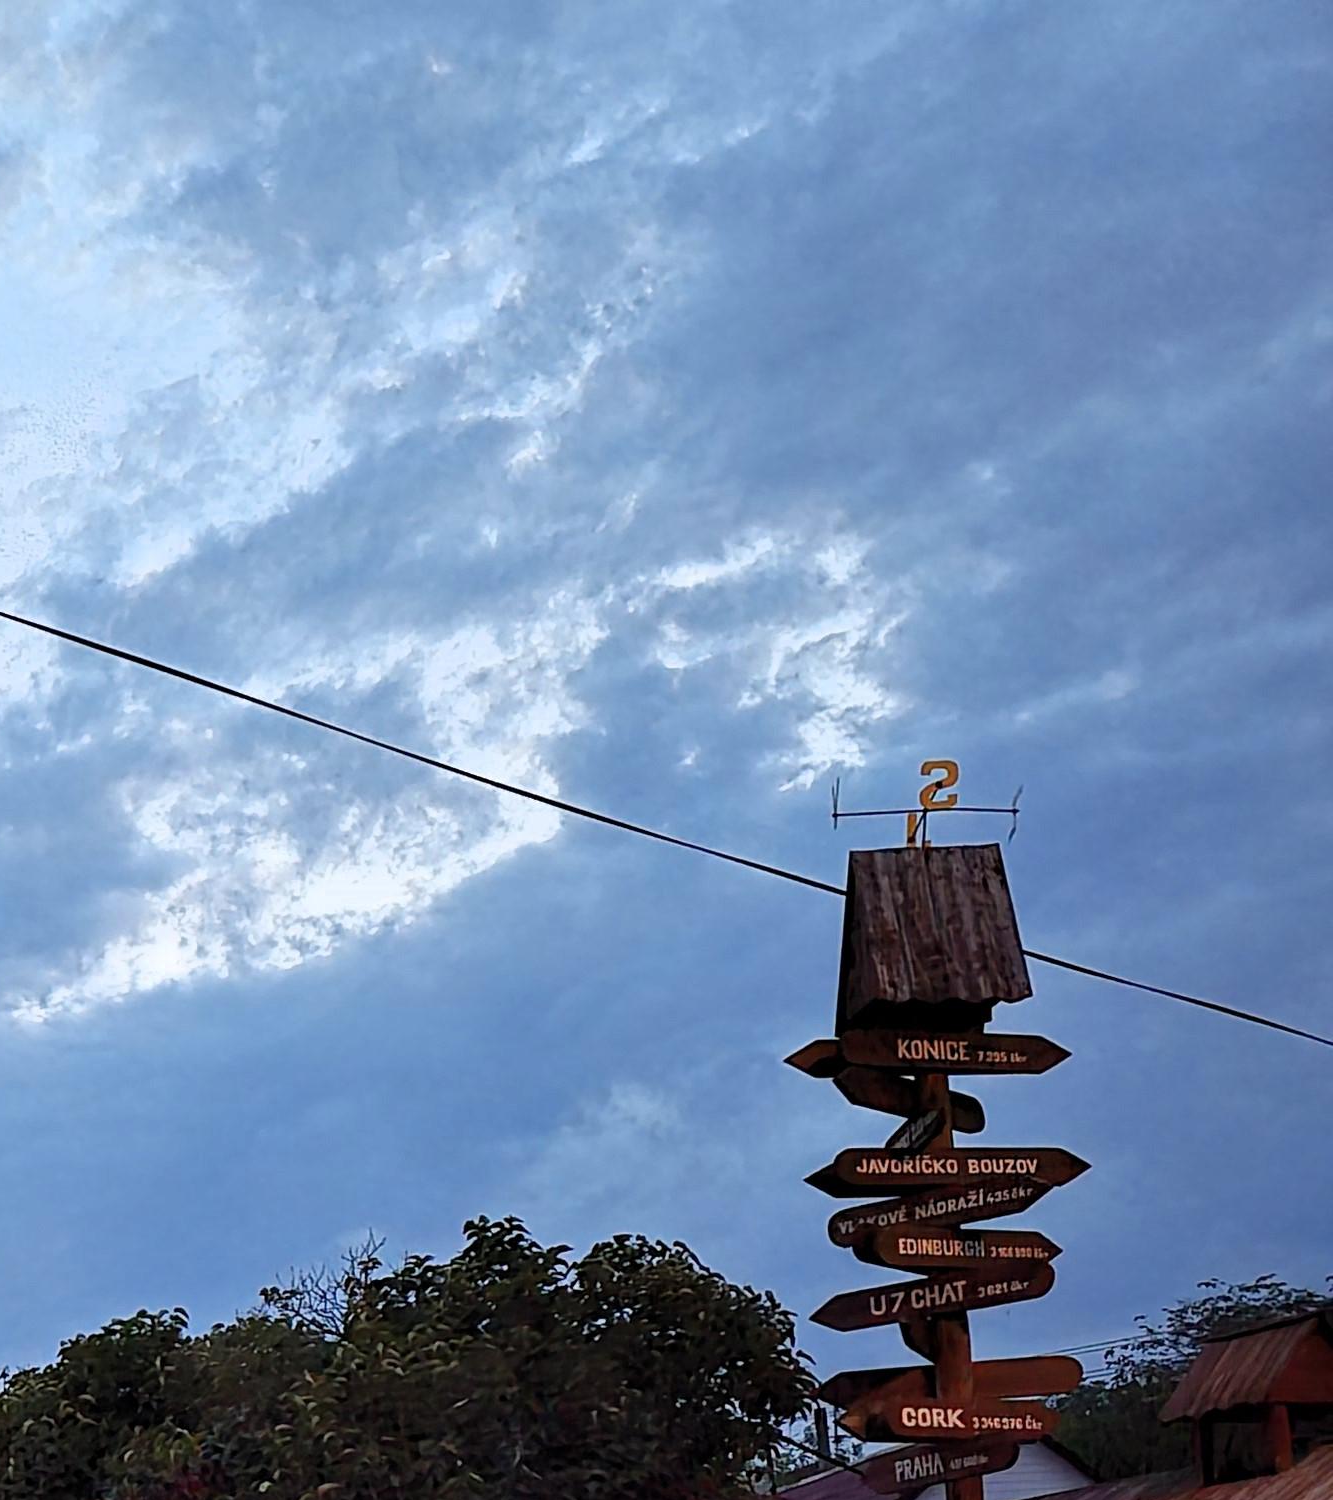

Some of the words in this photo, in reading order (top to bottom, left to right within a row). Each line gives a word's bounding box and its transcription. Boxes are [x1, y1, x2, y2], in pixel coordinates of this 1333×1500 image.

[897, 1039, 971, 1061] KONICE
[856, 1154, 958, 1175] JAVOŘÍČKO
[967, 1158, 1038, 1175] BOUZOV
[898, 1238, 985, 1257] EDINBURGH
[911, 1280, 967, 1309] CHAT
[901, 1407, 966, 1429] CORK
[894, 1453, 945, 1483] PRAHA
